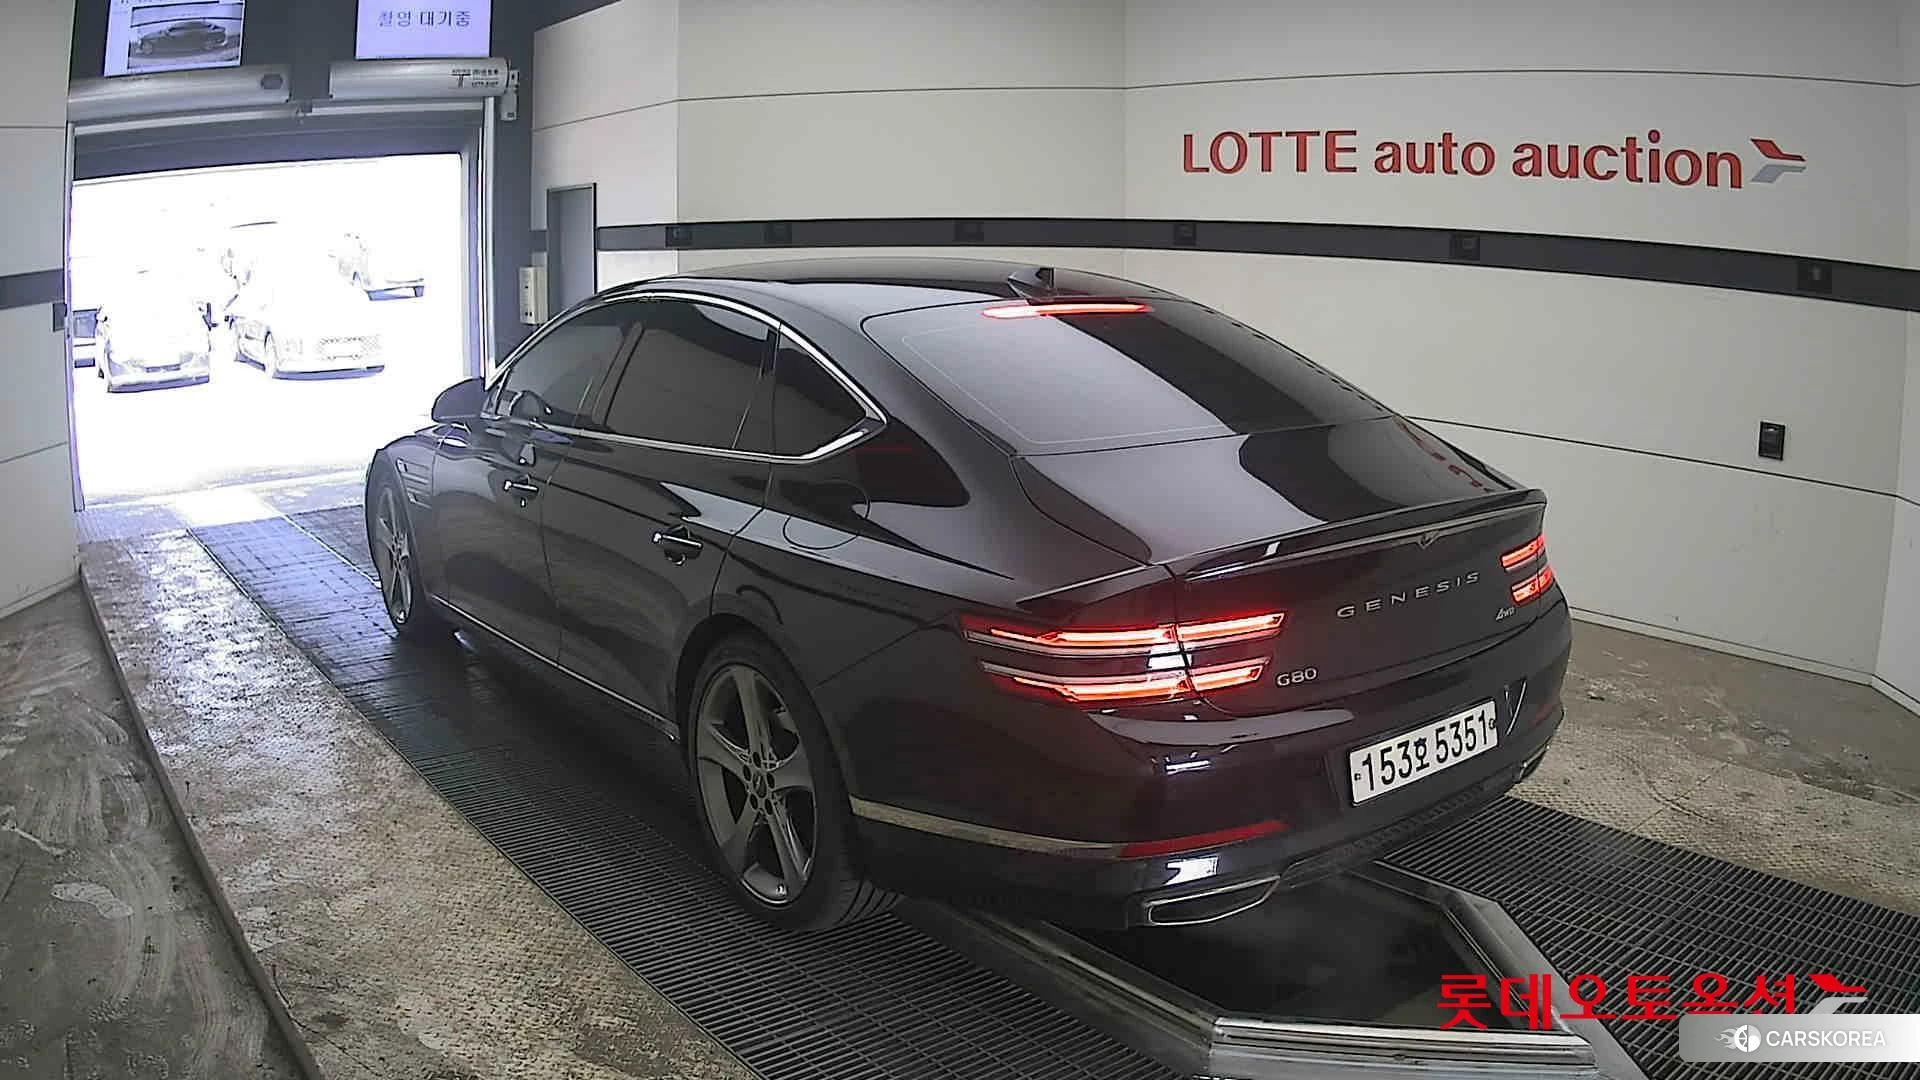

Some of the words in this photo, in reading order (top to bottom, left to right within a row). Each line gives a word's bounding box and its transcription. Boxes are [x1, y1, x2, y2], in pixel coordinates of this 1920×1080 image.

[420, 11, 471, 27] 대기중
[1183, 130, 1357, 174] LOTTE
[1374, 132, 1496, 176] auto
[1512, 129, 1743, 189] auction
[1336, 571, 1480, 619] GENESIS
[1276, 666, 1318, 687] G80
[1435, 709, 1487, 764] 5351
